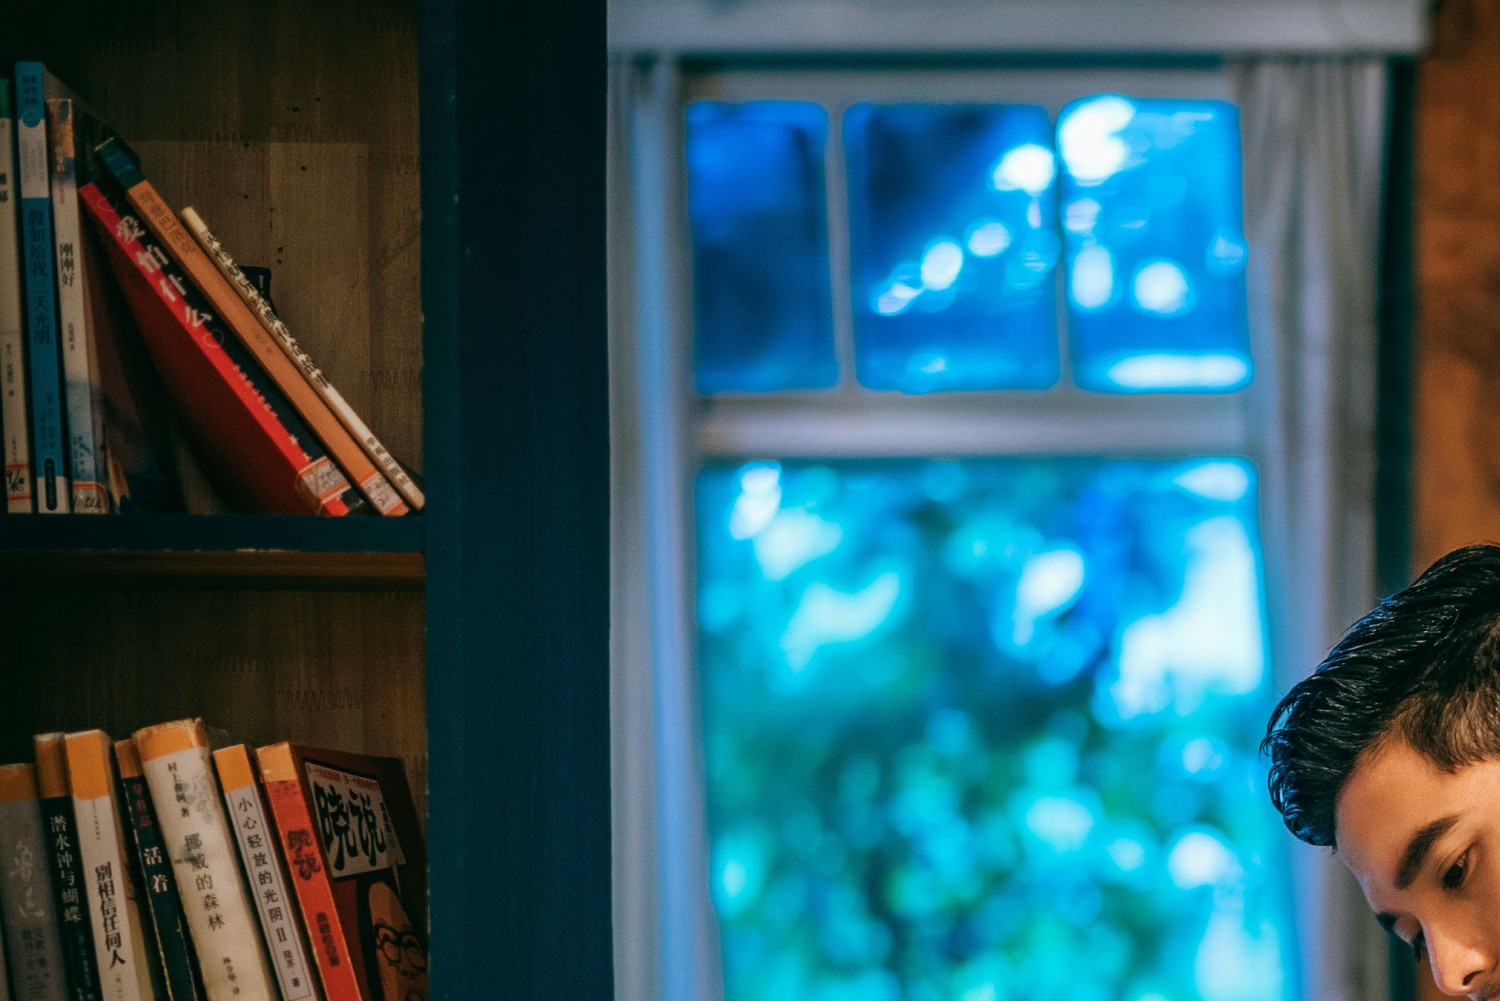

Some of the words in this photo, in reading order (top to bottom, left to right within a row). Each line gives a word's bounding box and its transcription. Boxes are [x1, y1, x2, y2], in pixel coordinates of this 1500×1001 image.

[28, 208, 51, 346] 假如给我三天光明
[49, 814, 82, 924] 潜水钟与蝴蝶
[314, 781, 386, 871] 晓说
[95, 862, 126, 969] 别相信任何人
[184, 833, 225, 931] 挪威的森林
